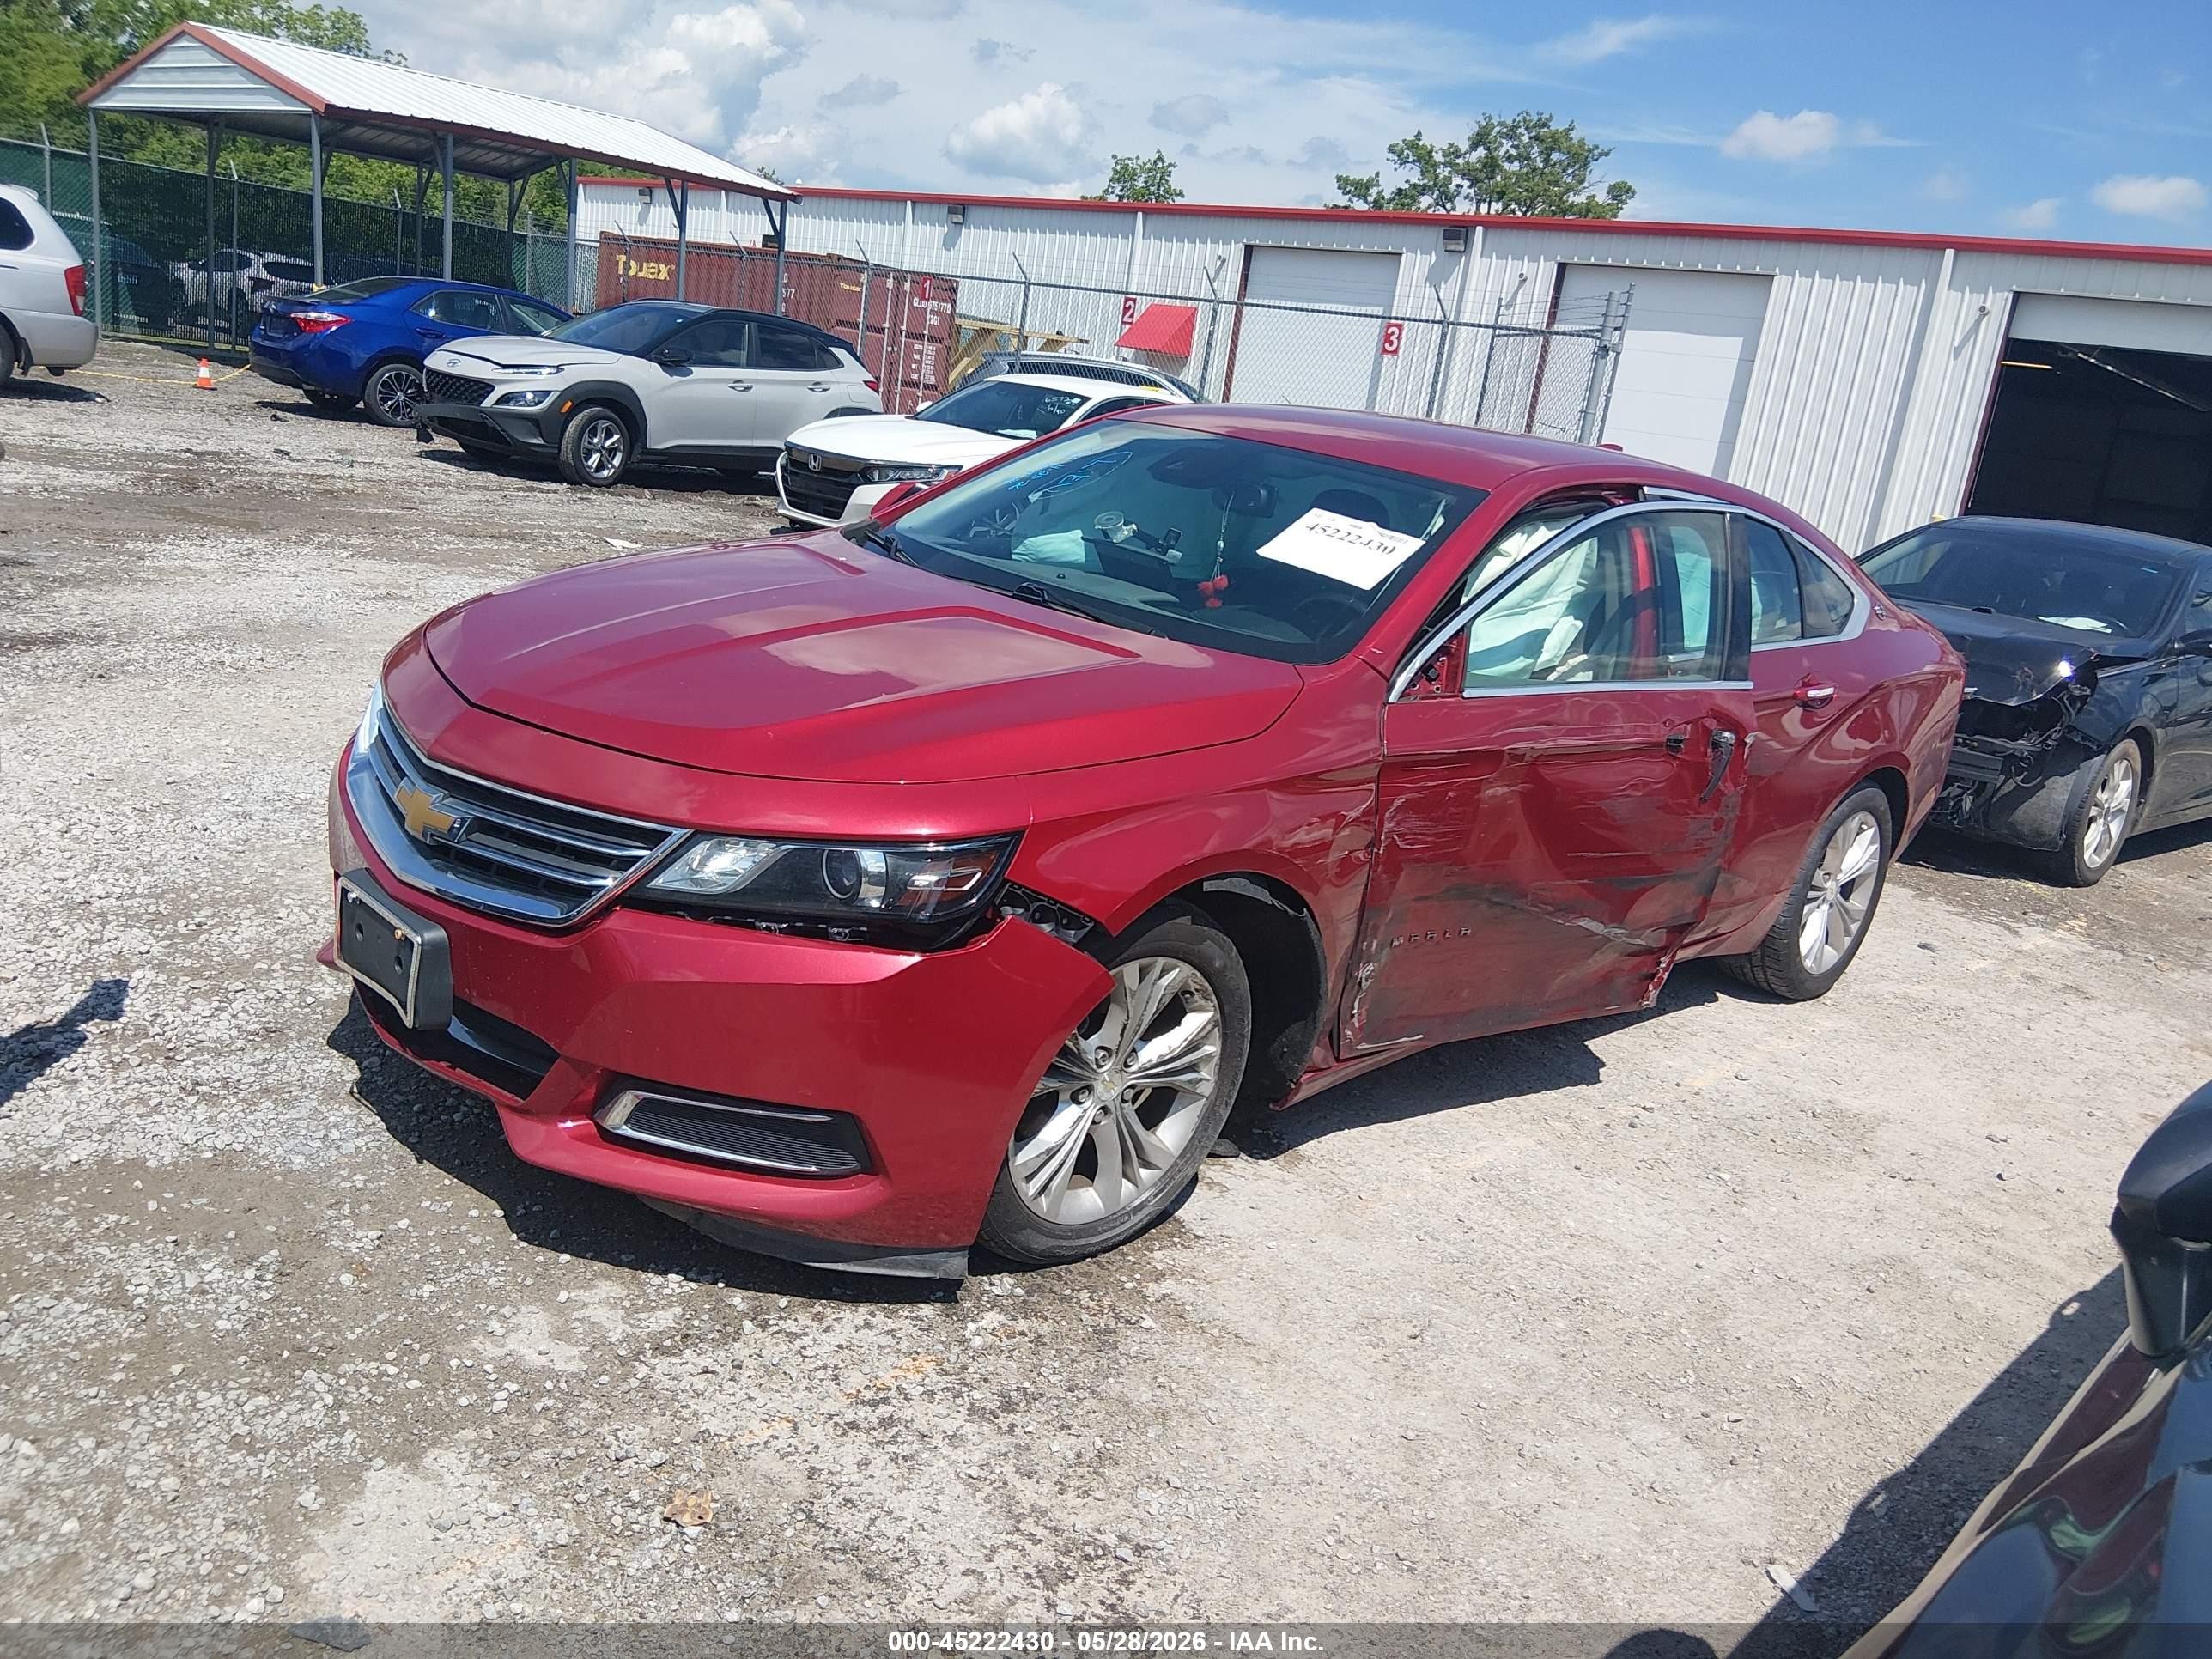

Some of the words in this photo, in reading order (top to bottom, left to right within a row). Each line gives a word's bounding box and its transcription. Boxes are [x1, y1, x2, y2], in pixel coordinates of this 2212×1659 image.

[923, 279, 931, 299] 1
[1122, 301, 1134, 322] 2
[1384, 326, 1400, 351] 3
[1305, 523, 1397, 555] 45222430
